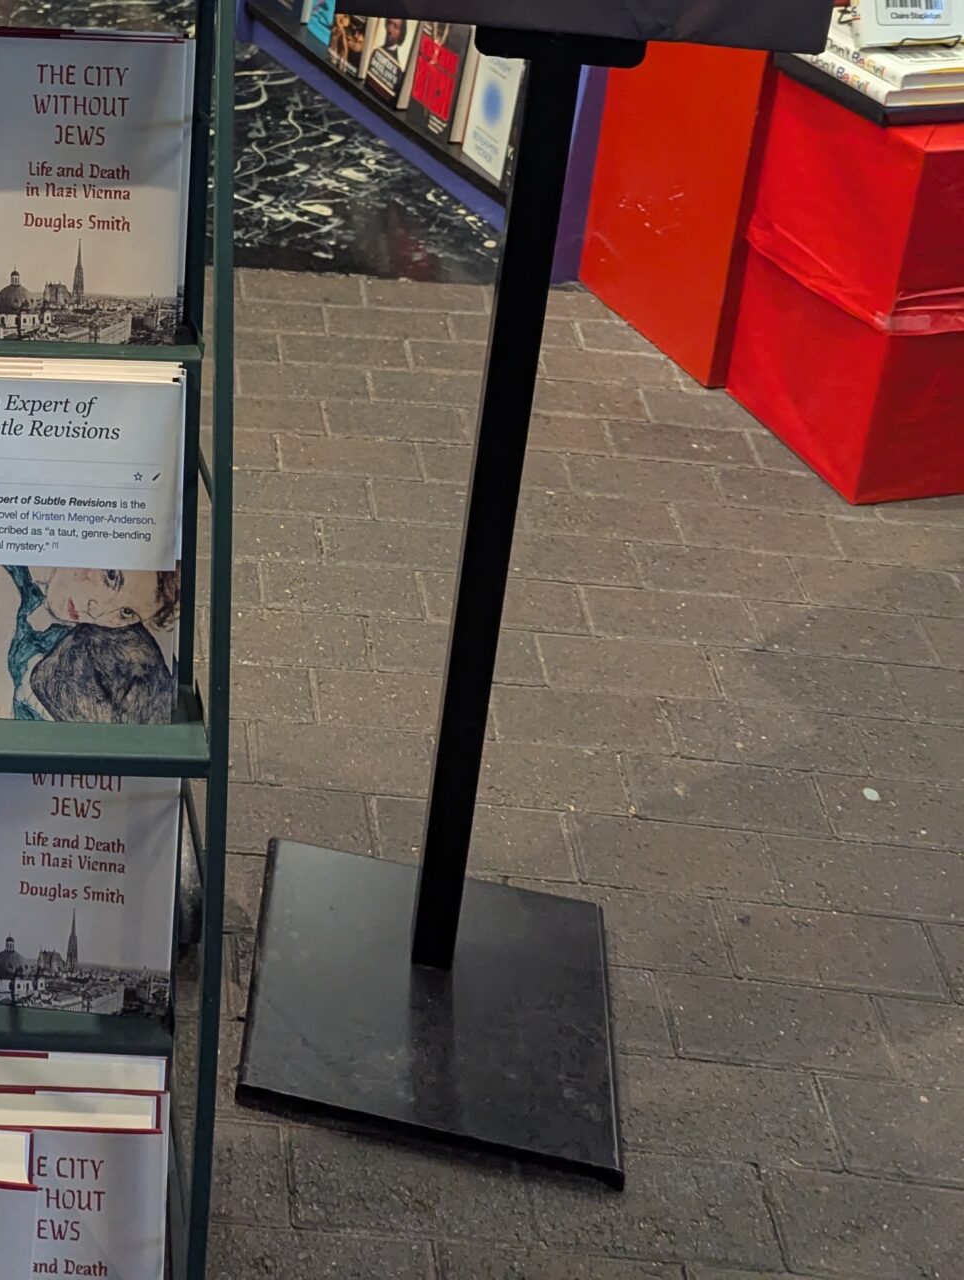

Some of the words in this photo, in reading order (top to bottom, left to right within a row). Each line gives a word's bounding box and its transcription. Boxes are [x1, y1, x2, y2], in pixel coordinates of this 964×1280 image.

[36, 64, 78, 86] THE
[82, 65, 129, 89] CITY
[32, 95, 130, 117] WITHOUT
[54, 126, 106, 147] JEWS
[27, 161, 52, 179] Life
[56, 163, 84, 178] and
[88, 163, 131, 181] Death
[25, 182, 41, 197] in
[44, 183, 78, 201] Nazi
[82, 184, 131, 202] Vienna
[23, 213, 83, 233] Douglas
[88, 215, 131, 233] Smith
[5, 394, 71, 416] Expert
[75, 397, 98, 418] of
[28, 420, 120, 440] Revisions
[21, 495, 32, 505] of
[33, 496, 66, 506] Subtle
[69, 498, 117, 508] Revisions
[120, 499, 129, 508] is
[131, 500, 146, 509] the
[20, 511, 30, 520] of
[32, 511, 65, 521] Kirsten
[68, 513, 156, 525] Menger-Anderson.
[31, 528, 42, 536] as
[58, 528, 78, 538] taut,
[82, 529, 151, 542] genre-bending
